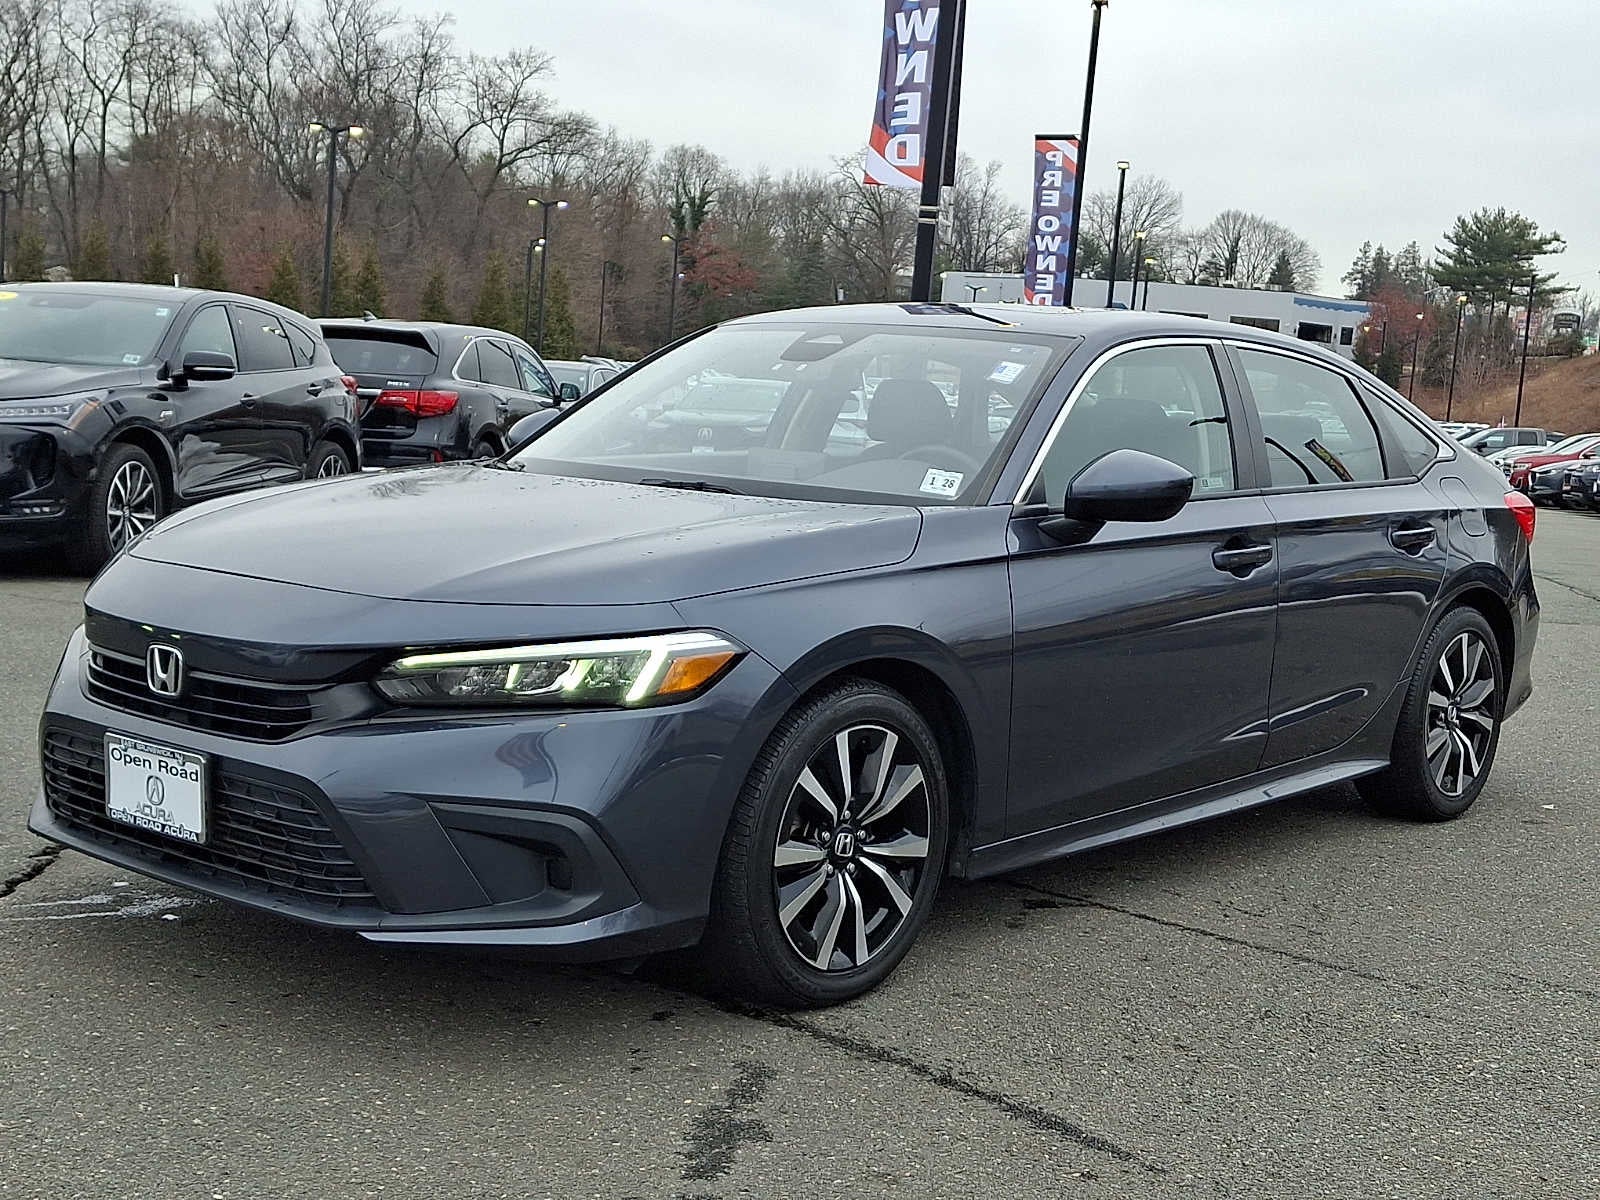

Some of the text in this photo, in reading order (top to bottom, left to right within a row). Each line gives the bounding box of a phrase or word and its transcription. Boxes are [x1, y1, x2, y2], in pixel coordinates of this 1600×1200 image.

[111, 747, 199, 782] Open Road
[110, 809, 198, 841] OPEN ROAD ACURA
[135, 802, 175, 824] ACURA
